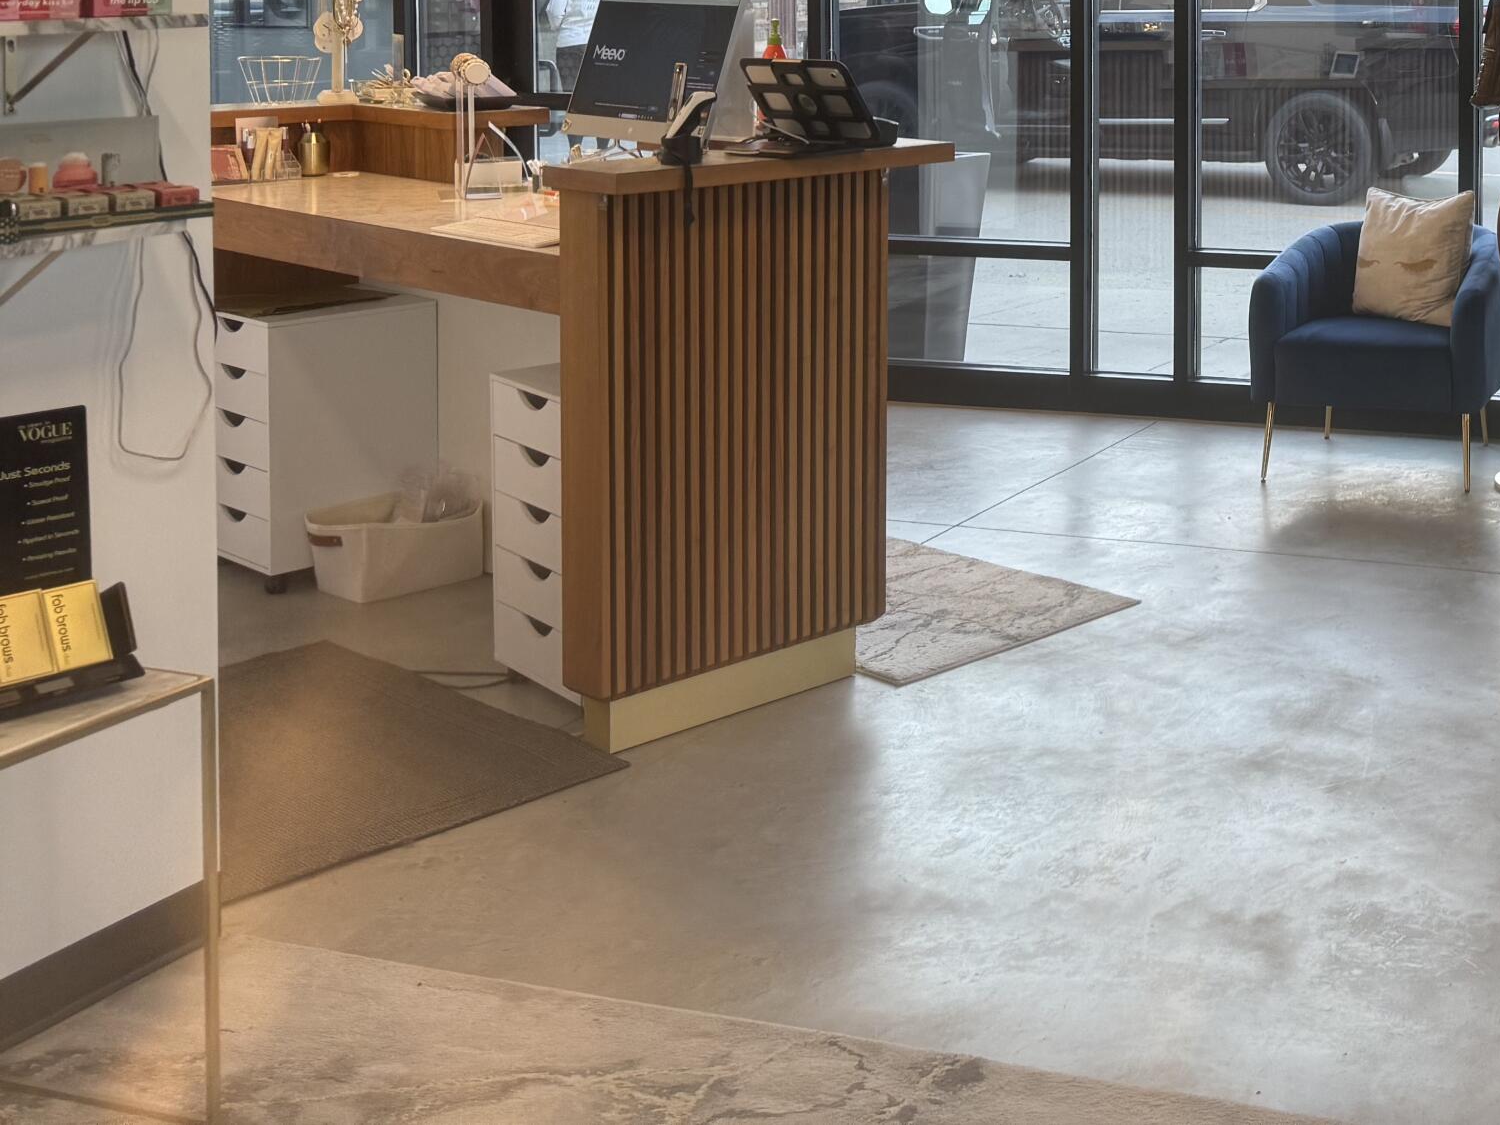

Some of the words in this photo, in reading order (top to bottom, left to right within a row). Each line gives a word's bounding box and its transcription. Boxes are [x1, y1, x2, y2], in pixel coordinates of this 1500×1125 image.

[593, 44, 626, 61] Meevo
[19, 421, 72, 442] VOGUE
[23, 461, 71, 477] Seconds
[51, 593, 67, 614] fab
[0, 624, 14, 664] brows
[56, 614, 72, 653] brows
